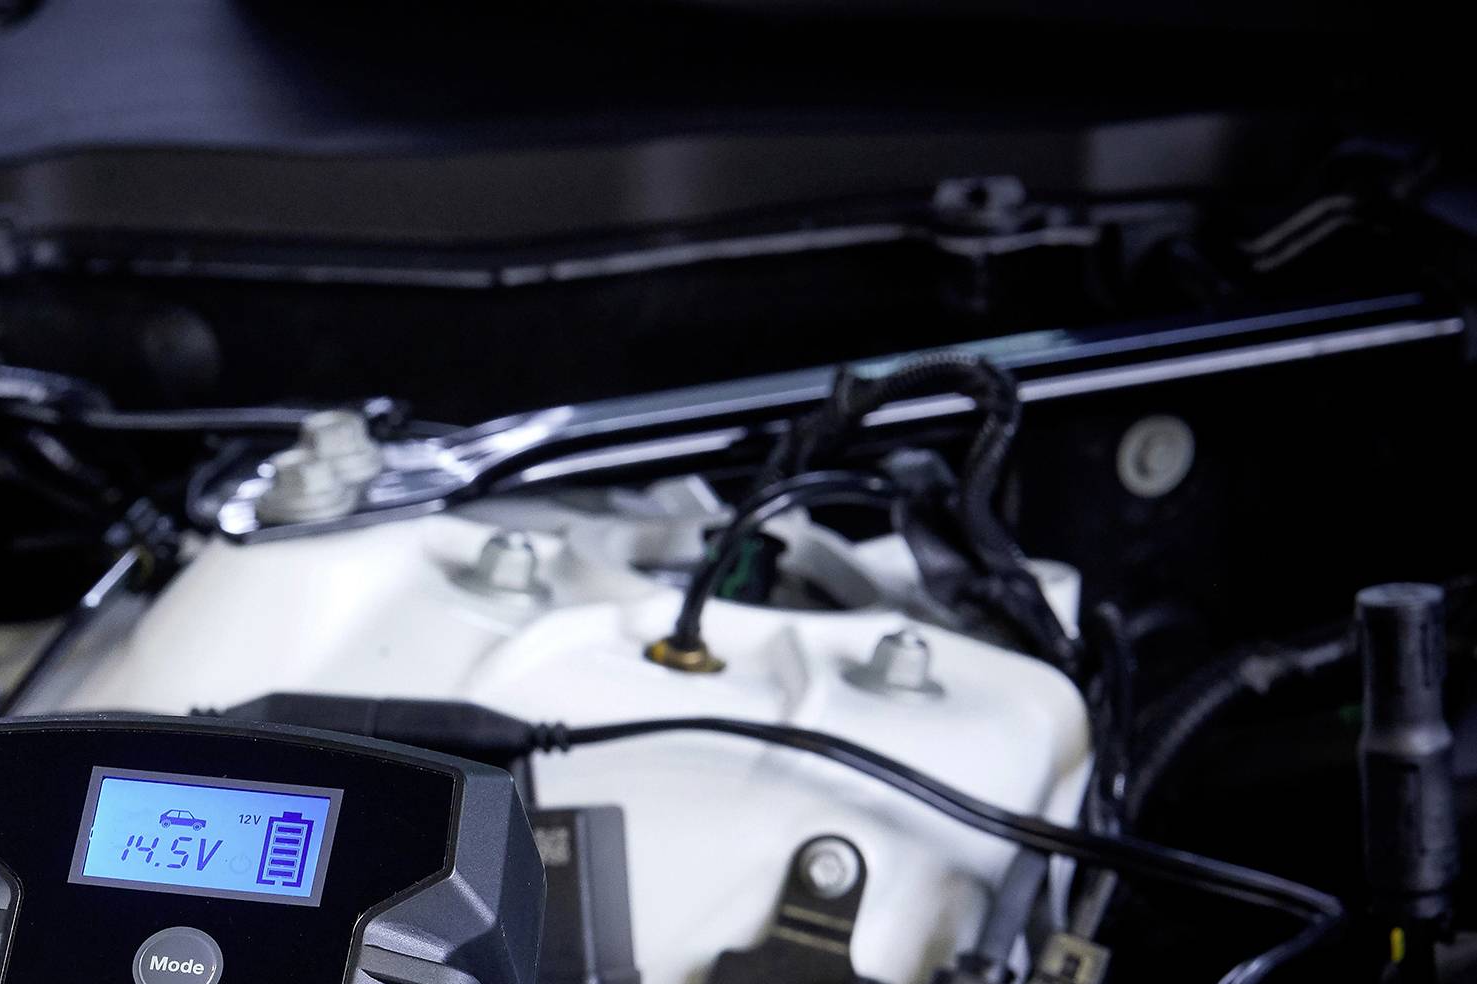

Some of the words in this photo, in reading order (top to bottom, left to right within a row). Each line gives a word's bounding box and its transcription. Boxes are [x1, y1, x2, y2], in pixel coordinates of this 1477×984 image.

[237, 813, 262, 826] 12V
[121, 834, 224, 871] 14.5V
[149, 955, 205, 975] Mode
